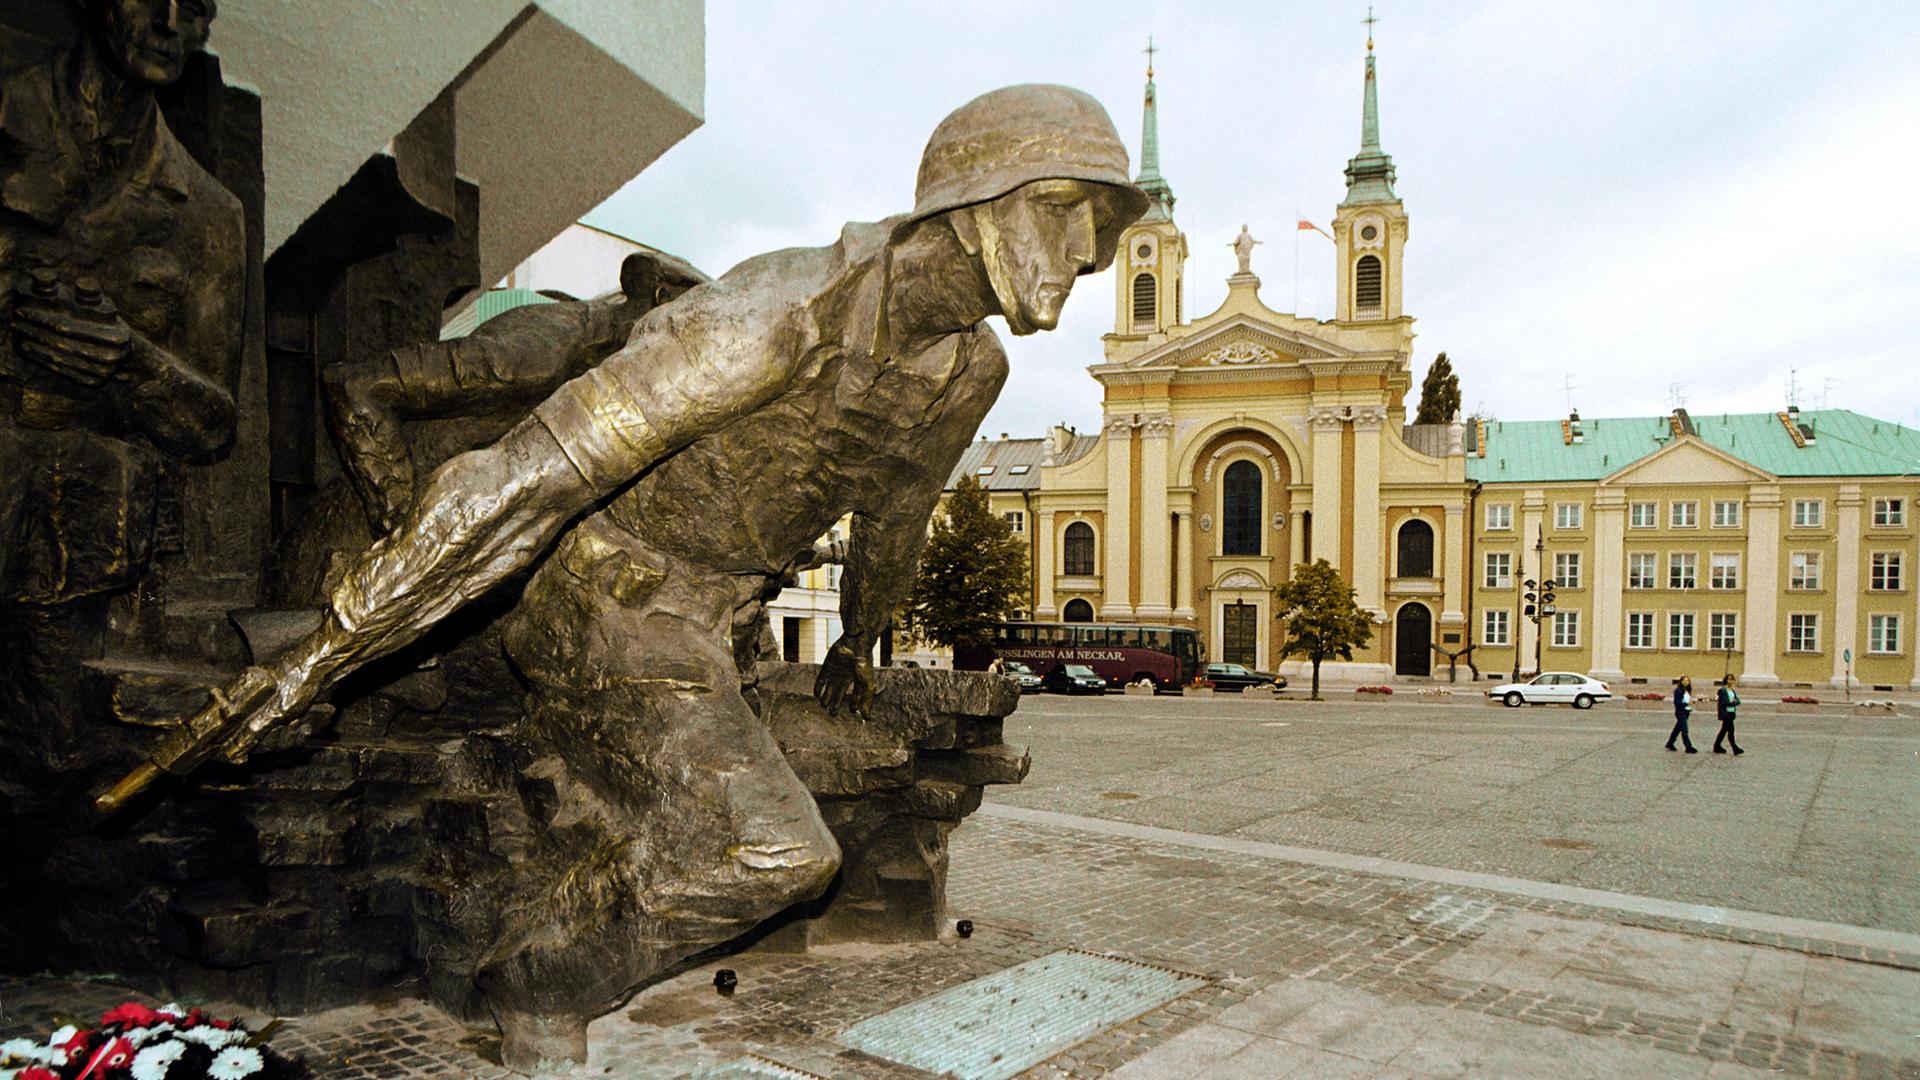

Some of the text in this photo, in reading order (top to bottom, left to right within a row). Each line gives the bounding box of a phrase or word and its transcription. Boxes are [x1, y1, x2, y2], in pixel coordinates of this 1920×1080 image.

[998, 649, 1125, 661] ESSLINGEN AM NECKAR
